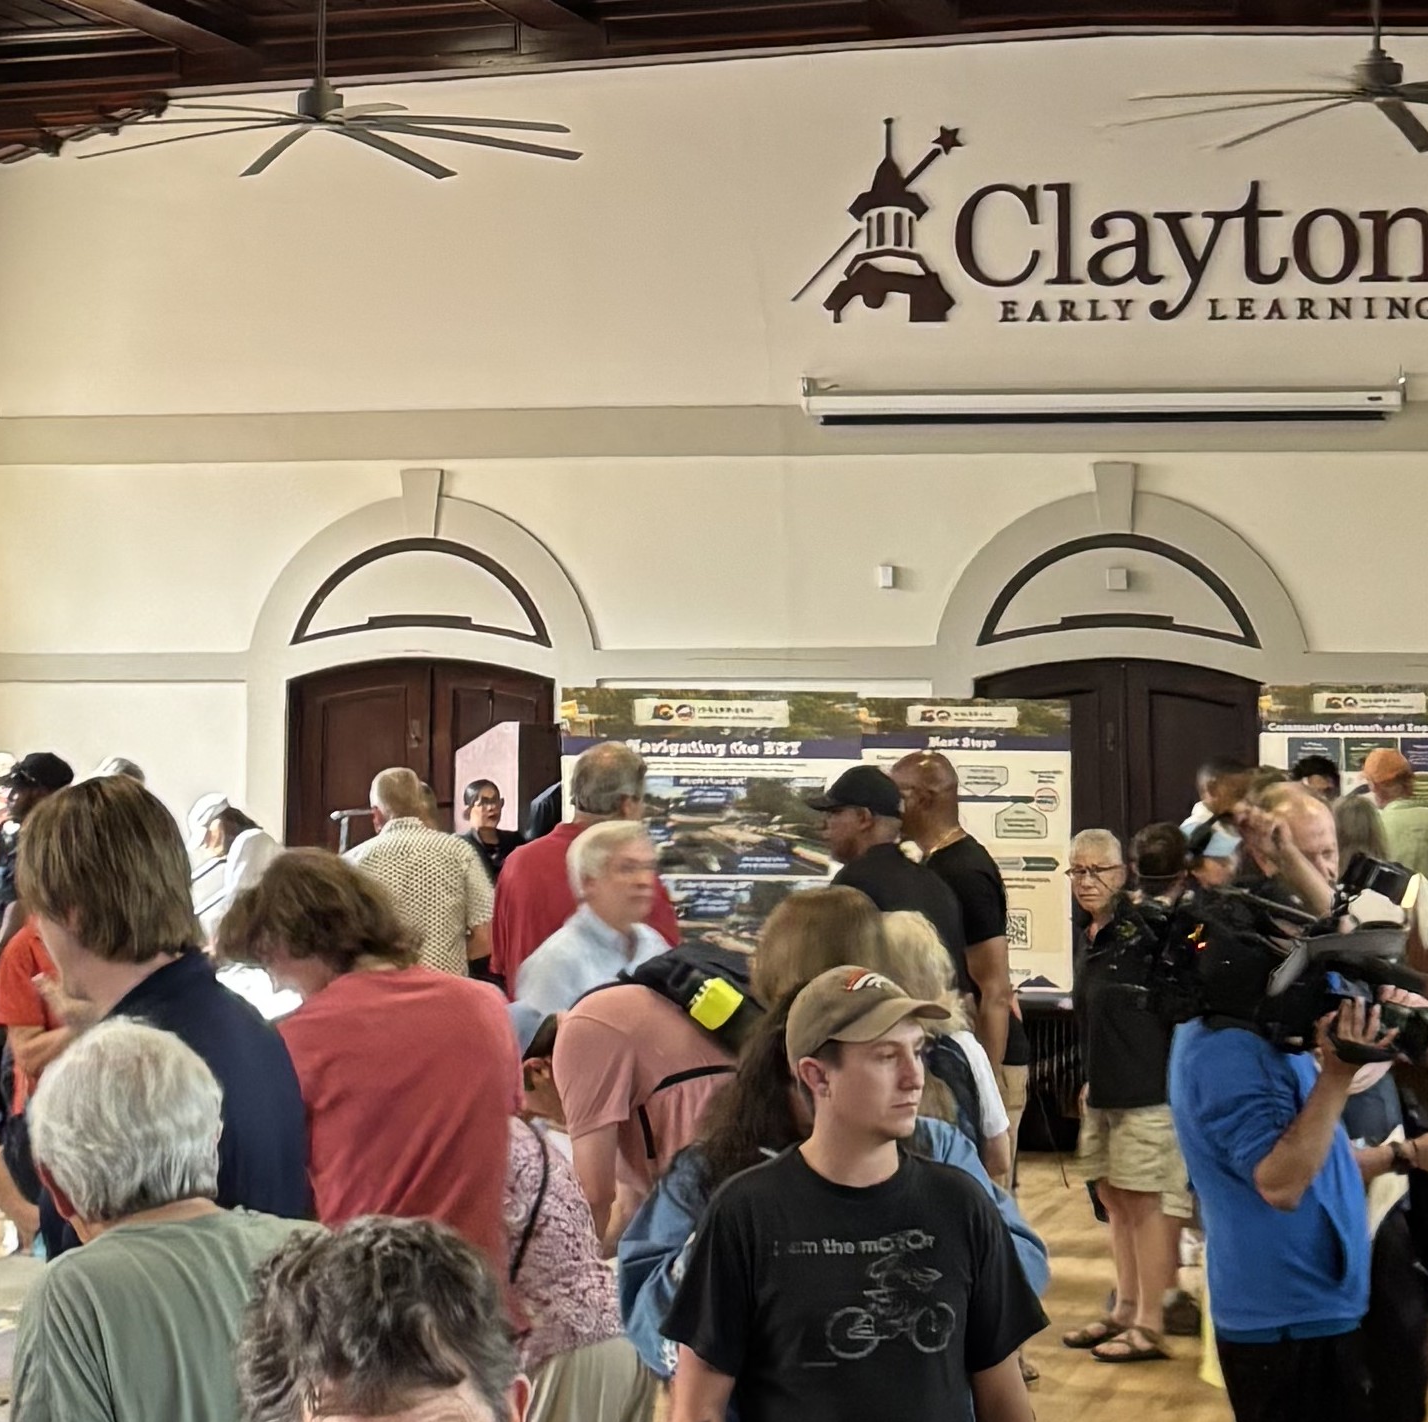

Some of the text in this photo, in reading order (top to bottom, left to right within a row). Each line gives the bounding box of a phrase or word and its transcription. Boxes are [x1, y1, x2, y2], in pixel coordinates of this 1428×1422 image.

[998, 299, 1133, 323] EARLY
[1268, 722, 1332, 733] Community
[1333, 722, 1383, 733] Outreach
[1384, 723, 1405, 732] and
[625, 738, 803, 758] Navigating the BRT
[928, 736, 997, 750] Next Steps
[788, 1240, 819, 1255] am
[822, 1238, 855, 1255] the
